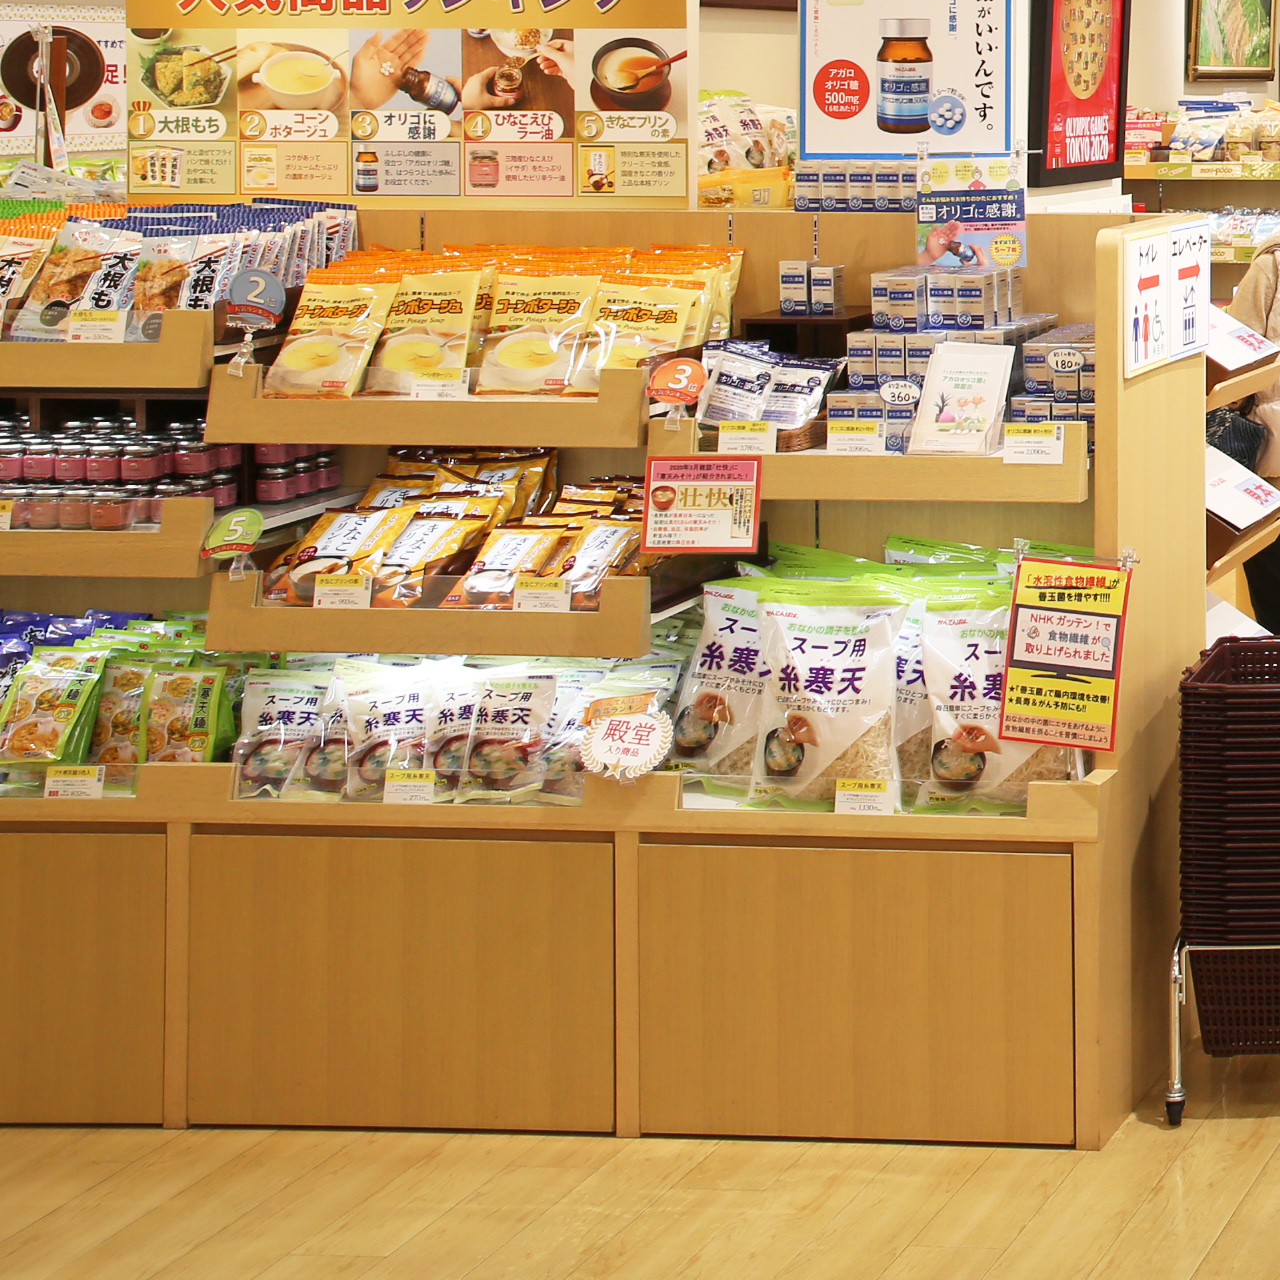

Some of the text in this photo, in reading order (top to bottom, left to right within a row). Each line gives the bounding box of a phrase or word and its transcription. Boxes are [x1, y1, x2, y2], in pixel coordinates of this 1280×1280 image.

[828, 69, 855, 78] アガロ
[825, 80, 859, 90] オリゴ糖
[825, 92, 860, 105] 500mg
[157, 115, 220, 134] 大根もち
[245, 115, 260, 136] 2
[294, 113, 330, 125] コーン
[358, 115, 372, 136] 3
[383, 113, 436, 126] オリゴに
[472, 115, 484, 136] 4
[495, 113, 553, 126] ひなこえび
[584, 116, 599, 137] 5
[605, 115, 669, 129] きなこプリン
[1065, 115, 1109, 137] OLYMPIC GAMES
[269, 124, 329, 138] ポタージュ
[407, 125, 436, 140] 感謝
[516, 126, 553, 140] ラー油
[650, 128, 670, 139] の素
[1065, 136, 1090, 164] TOKYO
[1090, 135, 1109, 162] 2020
[1138, 243, 1158, 266] トイレ
[1171, 235, 1208, 258] エレベーター
[495, 298, 582, 315] コーンポタージュ
[406, 317, 427, 325] Potage
[428, 317, 445, 325] Soup
[525, 315, 546, 323] Potage
[599, 307, 678, 324] コーンポタージュ
[1235, 332, 1268, 353] 見本
[667, 364, 699, 392] 3位
[650, 388, 691, 402] 人気ランキング
[679, 487, 729, 508] 壮快
[1242, 482, 1277, 505] 見本
[335, 514, 369, 553] きなこ
[1029, 613, 1054, 625] NHK
[791, 636, 867, 658] スープ用
[1024, 642, 1111, 663] 取り上げられました
[778, 665, 866, 695] 糸寒天
[264, 694, 319, 708] スープ用
[368, 692, 420, 712] スープ用
[482, 688, 533, 703] スープ用
[364, 707, 425, 734] 糸寒天
[601, 719, 657, 746] 殿堂
[604, 745, 640, 757] 入り商品
[840, 782, 883, 790] スープ用糸寒天
